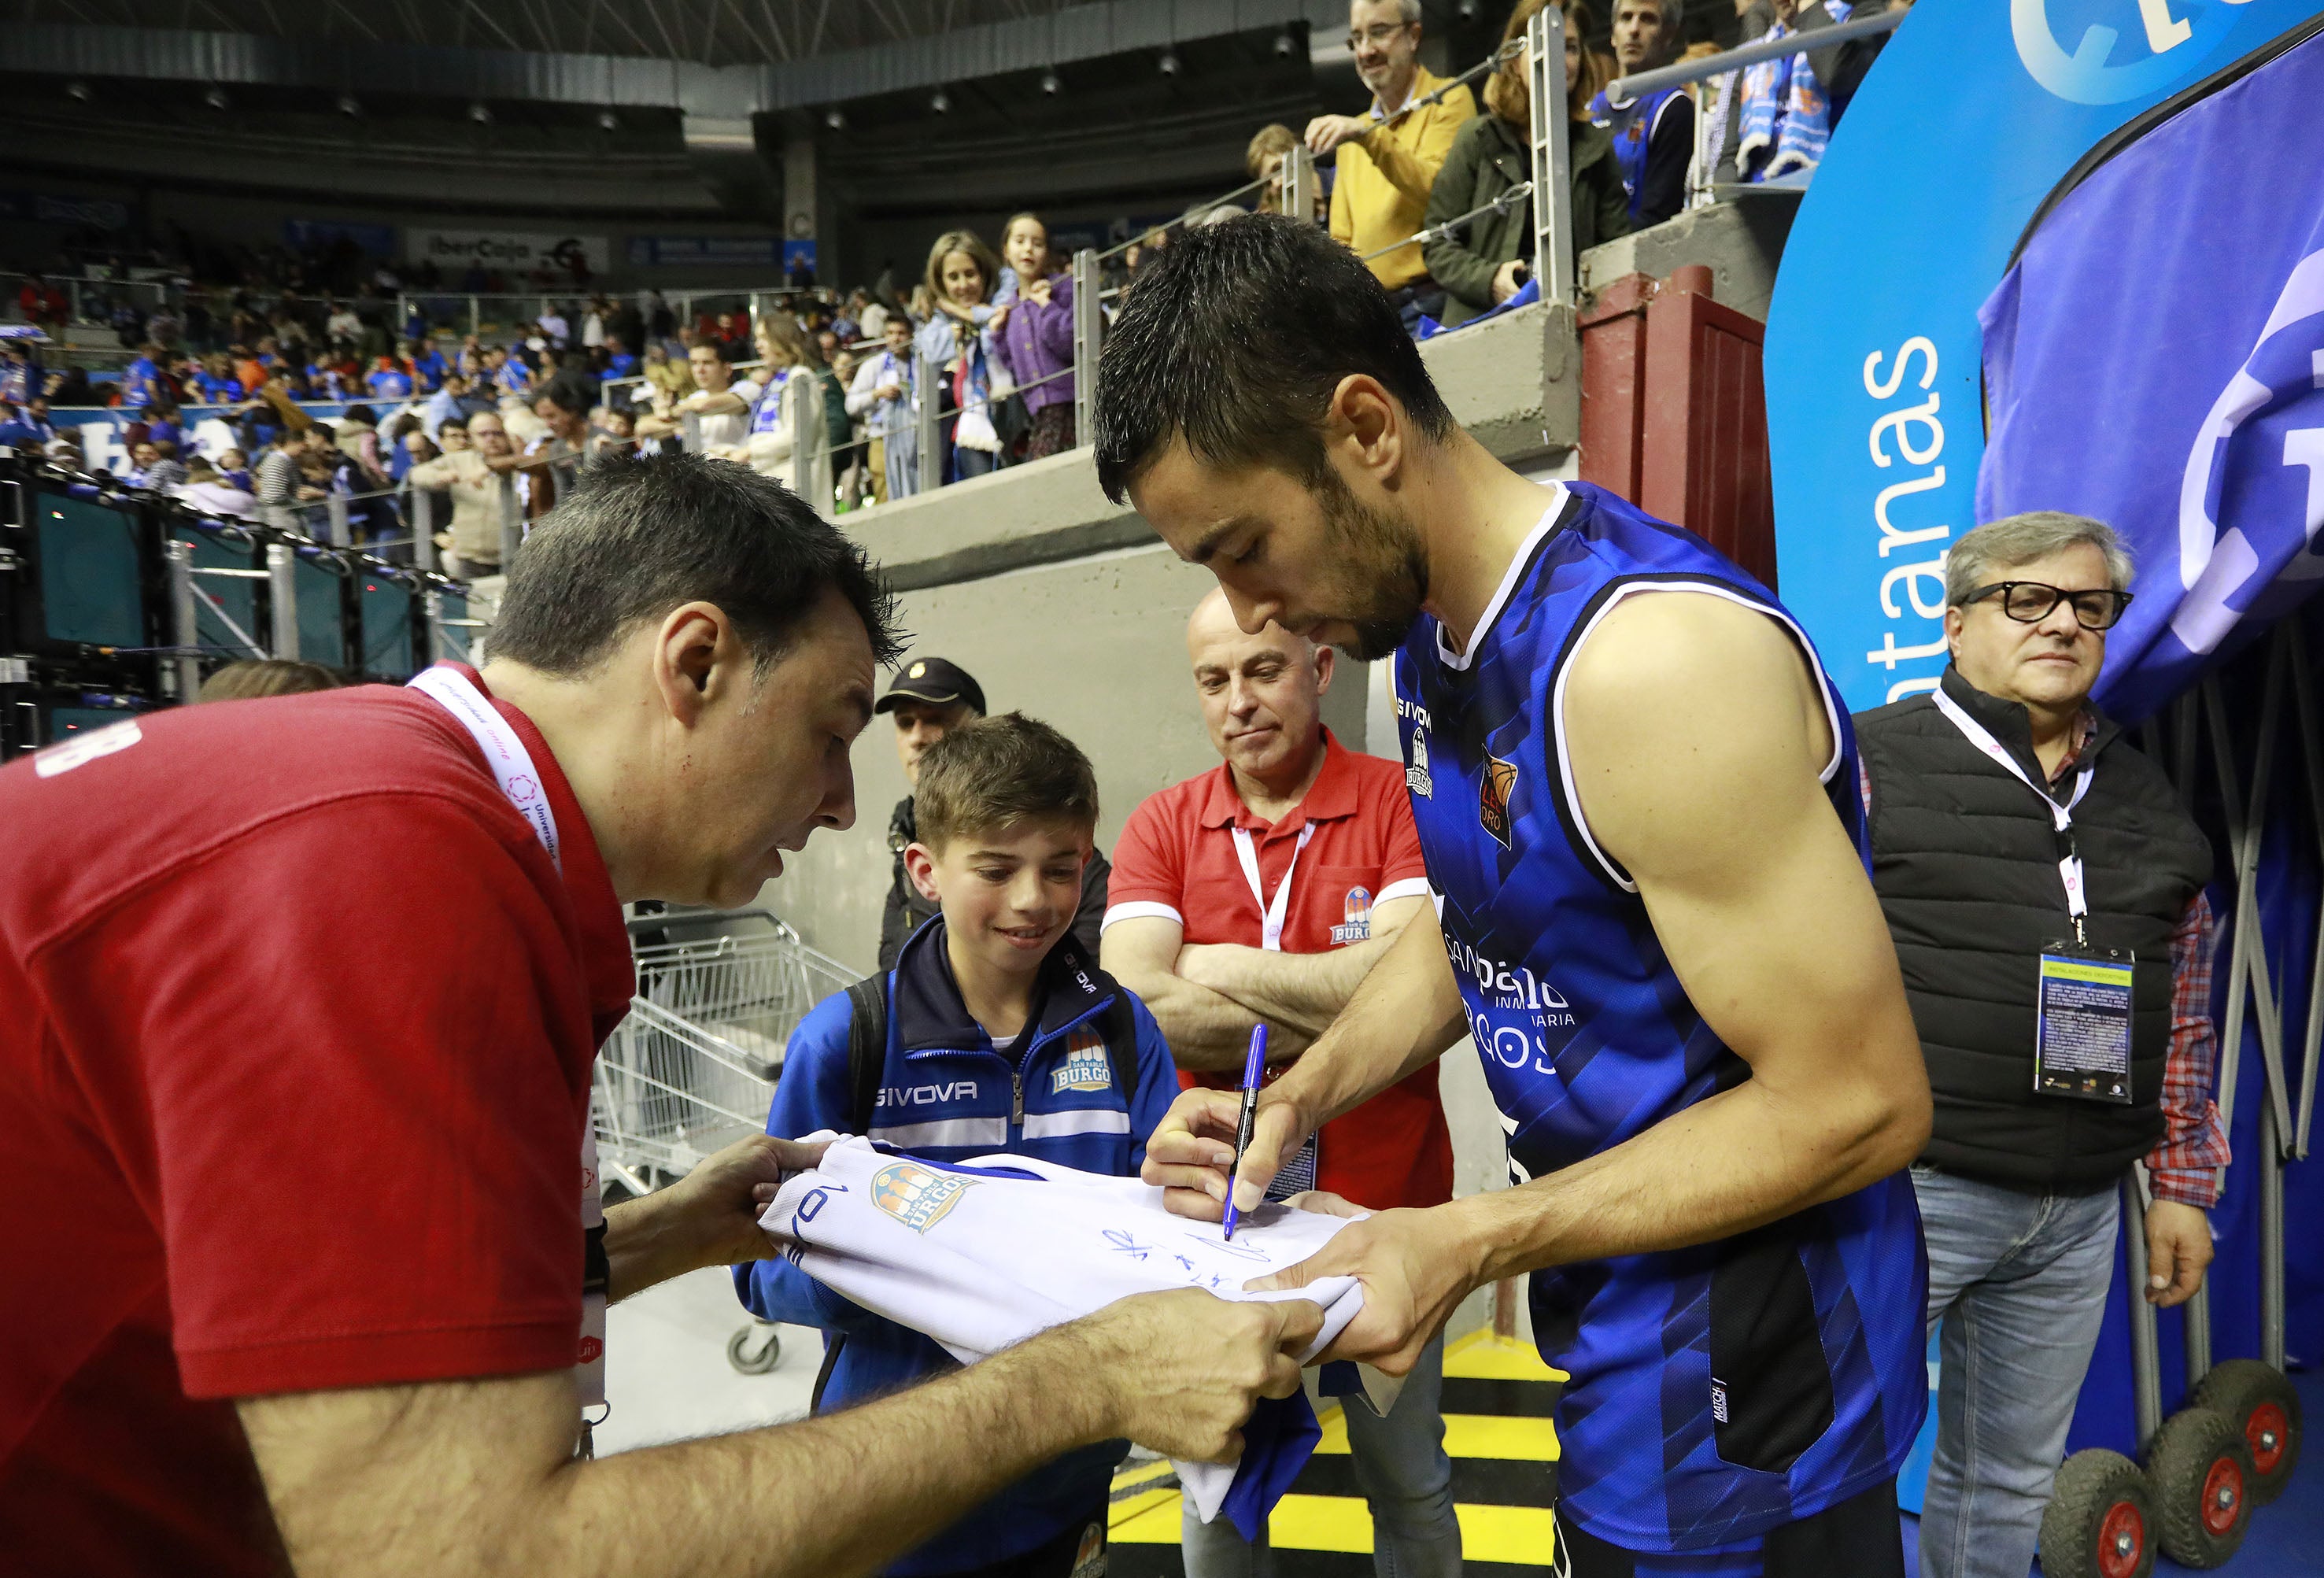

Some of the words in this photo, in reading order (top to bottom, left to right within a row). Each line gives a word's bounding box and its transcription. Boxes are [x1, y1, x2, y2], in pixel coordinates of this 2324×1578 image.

[486, 729, 511, 760] online
[1407, 771, 1432, 796] BURGOS
[1481, 805, 1501, 830] ORO
[1335, 927, 1371, 941] BUR
[1444, 933, 1480, 979] SAN
[1064, 952, 1098, 994] GIVOVA
[1058, 1067, 1111, 1087] BURGO
[907, 1200, 920, 1217] SAN
[918, 1181, 940, 1204] PABLO
[910, 1176, 974, 1229] URGOS
